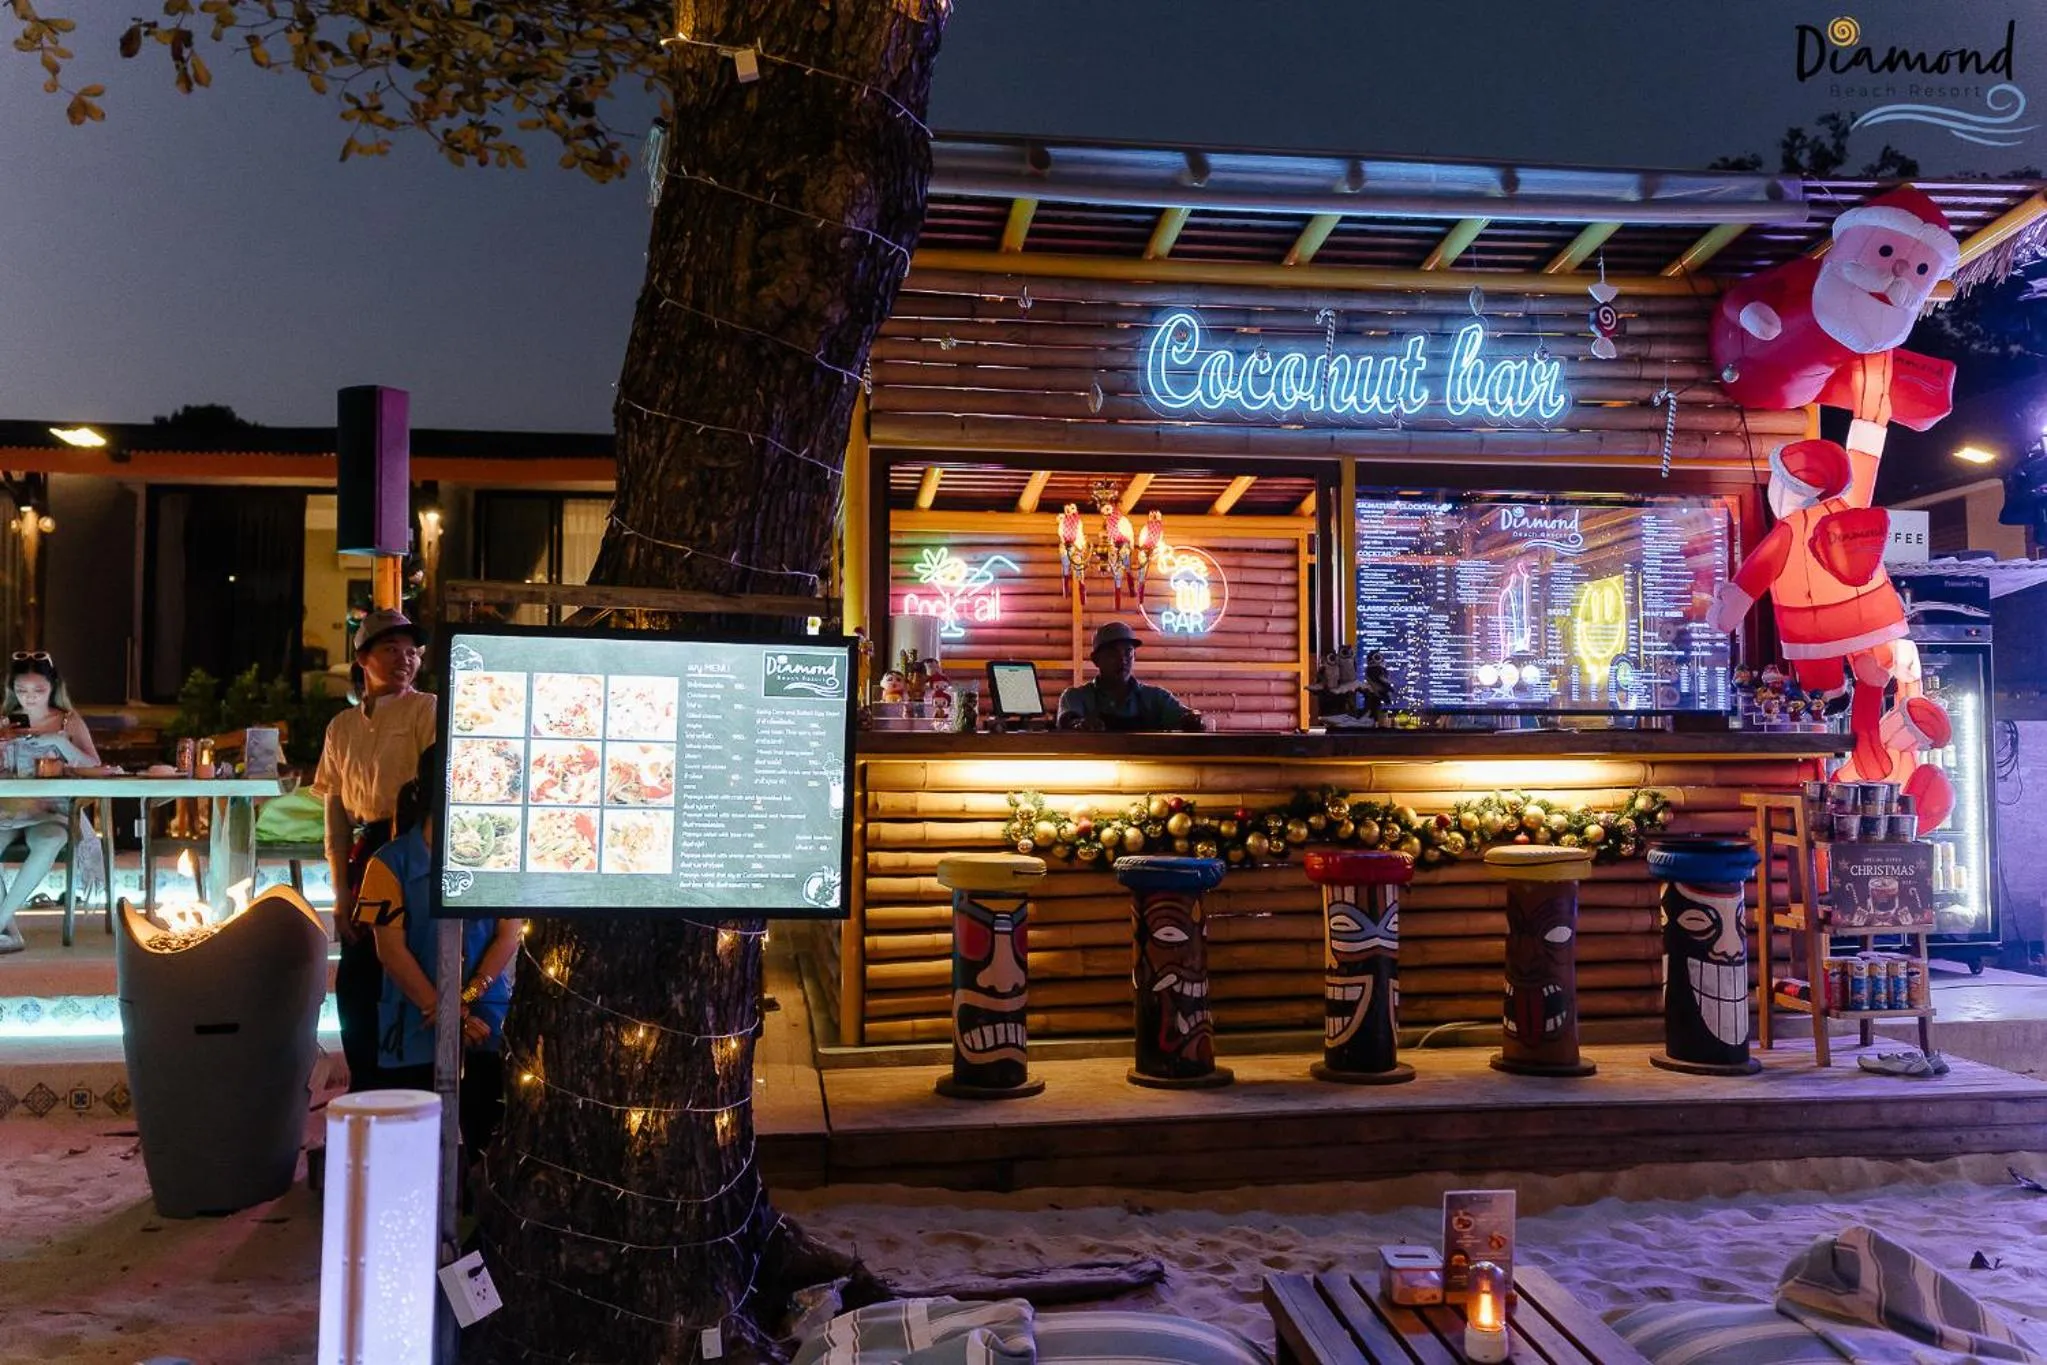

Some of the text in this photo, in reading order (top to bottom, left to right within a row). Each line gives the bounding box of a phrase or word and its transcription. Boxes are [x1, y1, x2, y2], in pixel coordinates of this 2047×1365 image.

[1147, 312, 1565, 418] Coconut bar
[1501, 507, 1580, 532] Diamond
[1889, 532, 1923, 544] FEE
[1160, 611, 1203, 633] BAR
[766, 655, 837, 677] Diamond
[1850, 865, 1915, 876] CHRISTMAS
